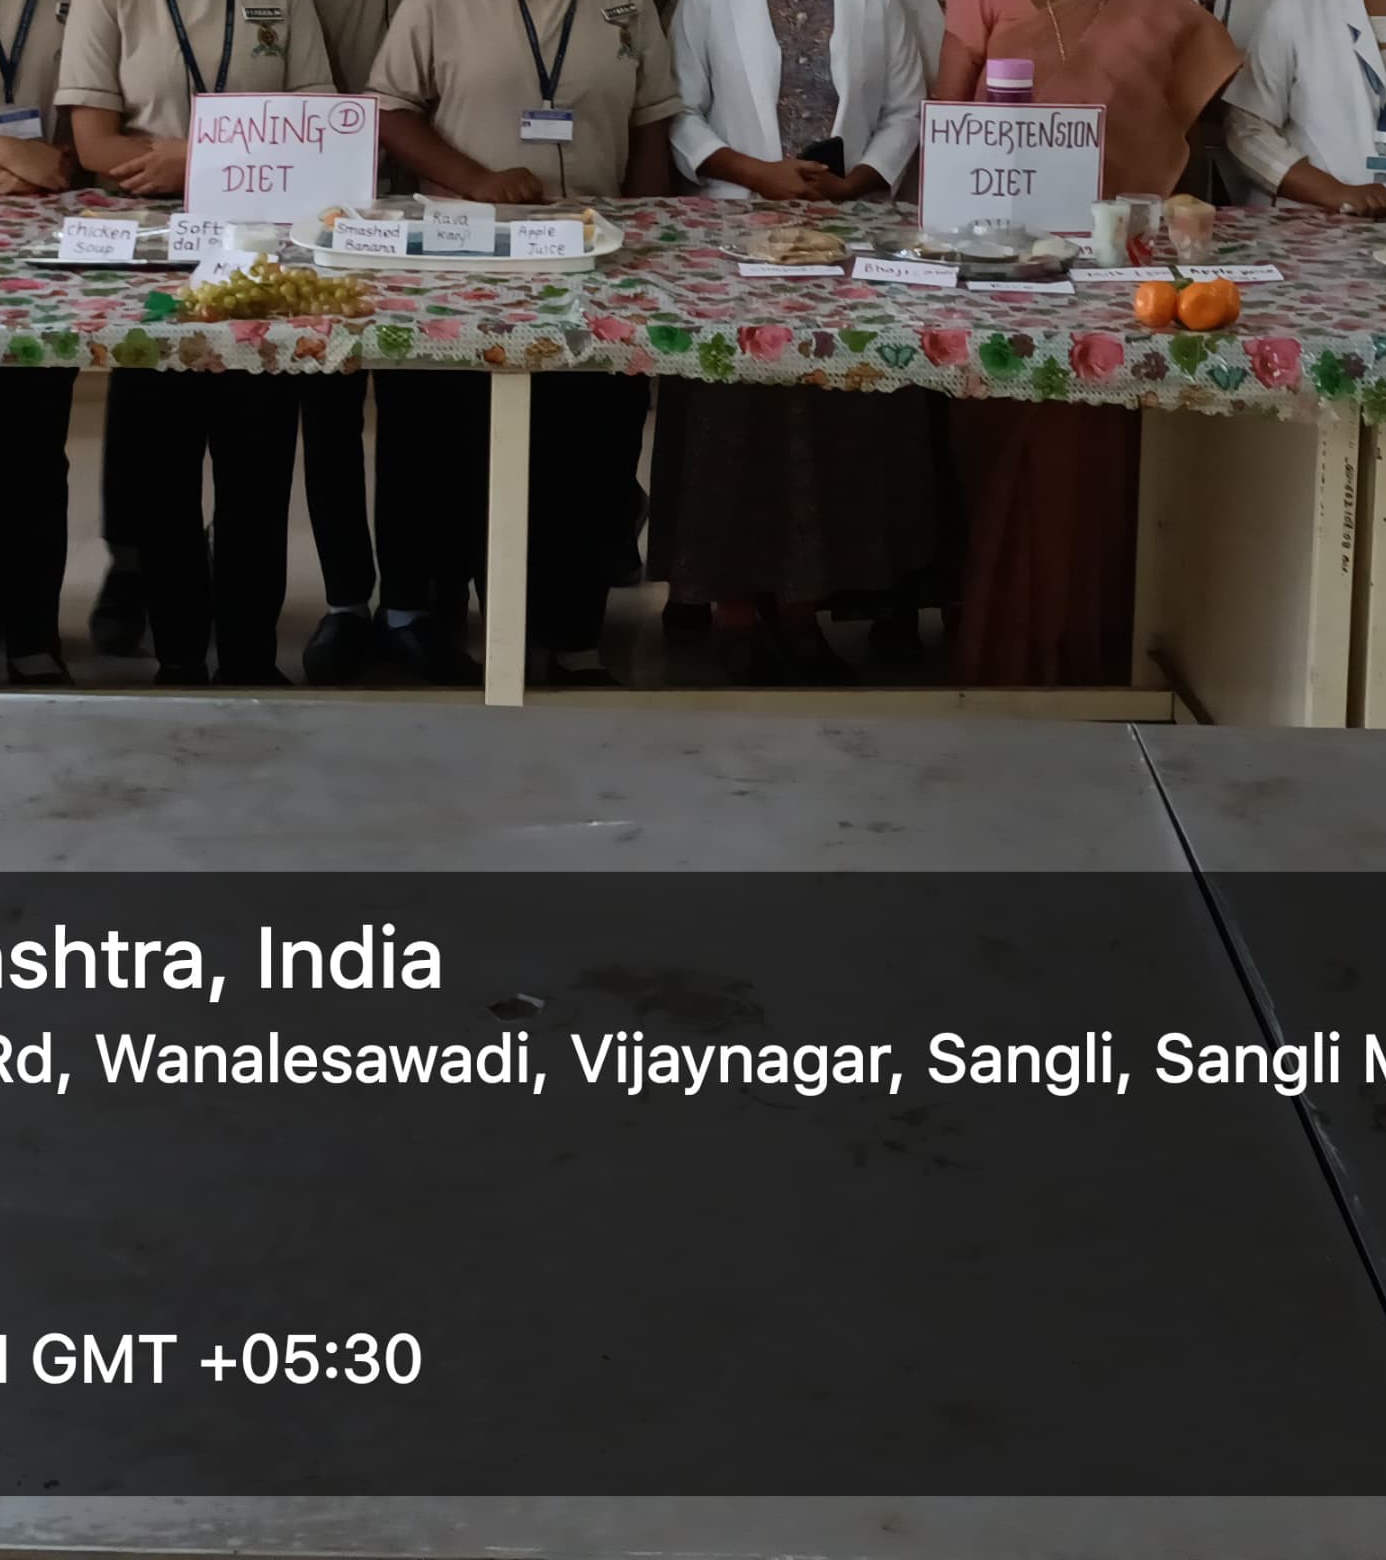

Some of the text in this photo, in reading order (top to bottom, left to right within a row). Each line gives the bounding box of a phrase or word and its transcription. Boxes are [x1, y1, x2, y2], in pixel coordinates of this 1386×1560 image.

[197, 100, 326, 154] WEANING
[931, 112, 1100, 155] HYPERTENSION
[222, 165, 294, 193] DIET
[970, 168, 1037, 197] DIET
[176, 220, 224, 236] Soft
[519, 224, 556, 238] Apple
[173, 236, 201, 251] dal
